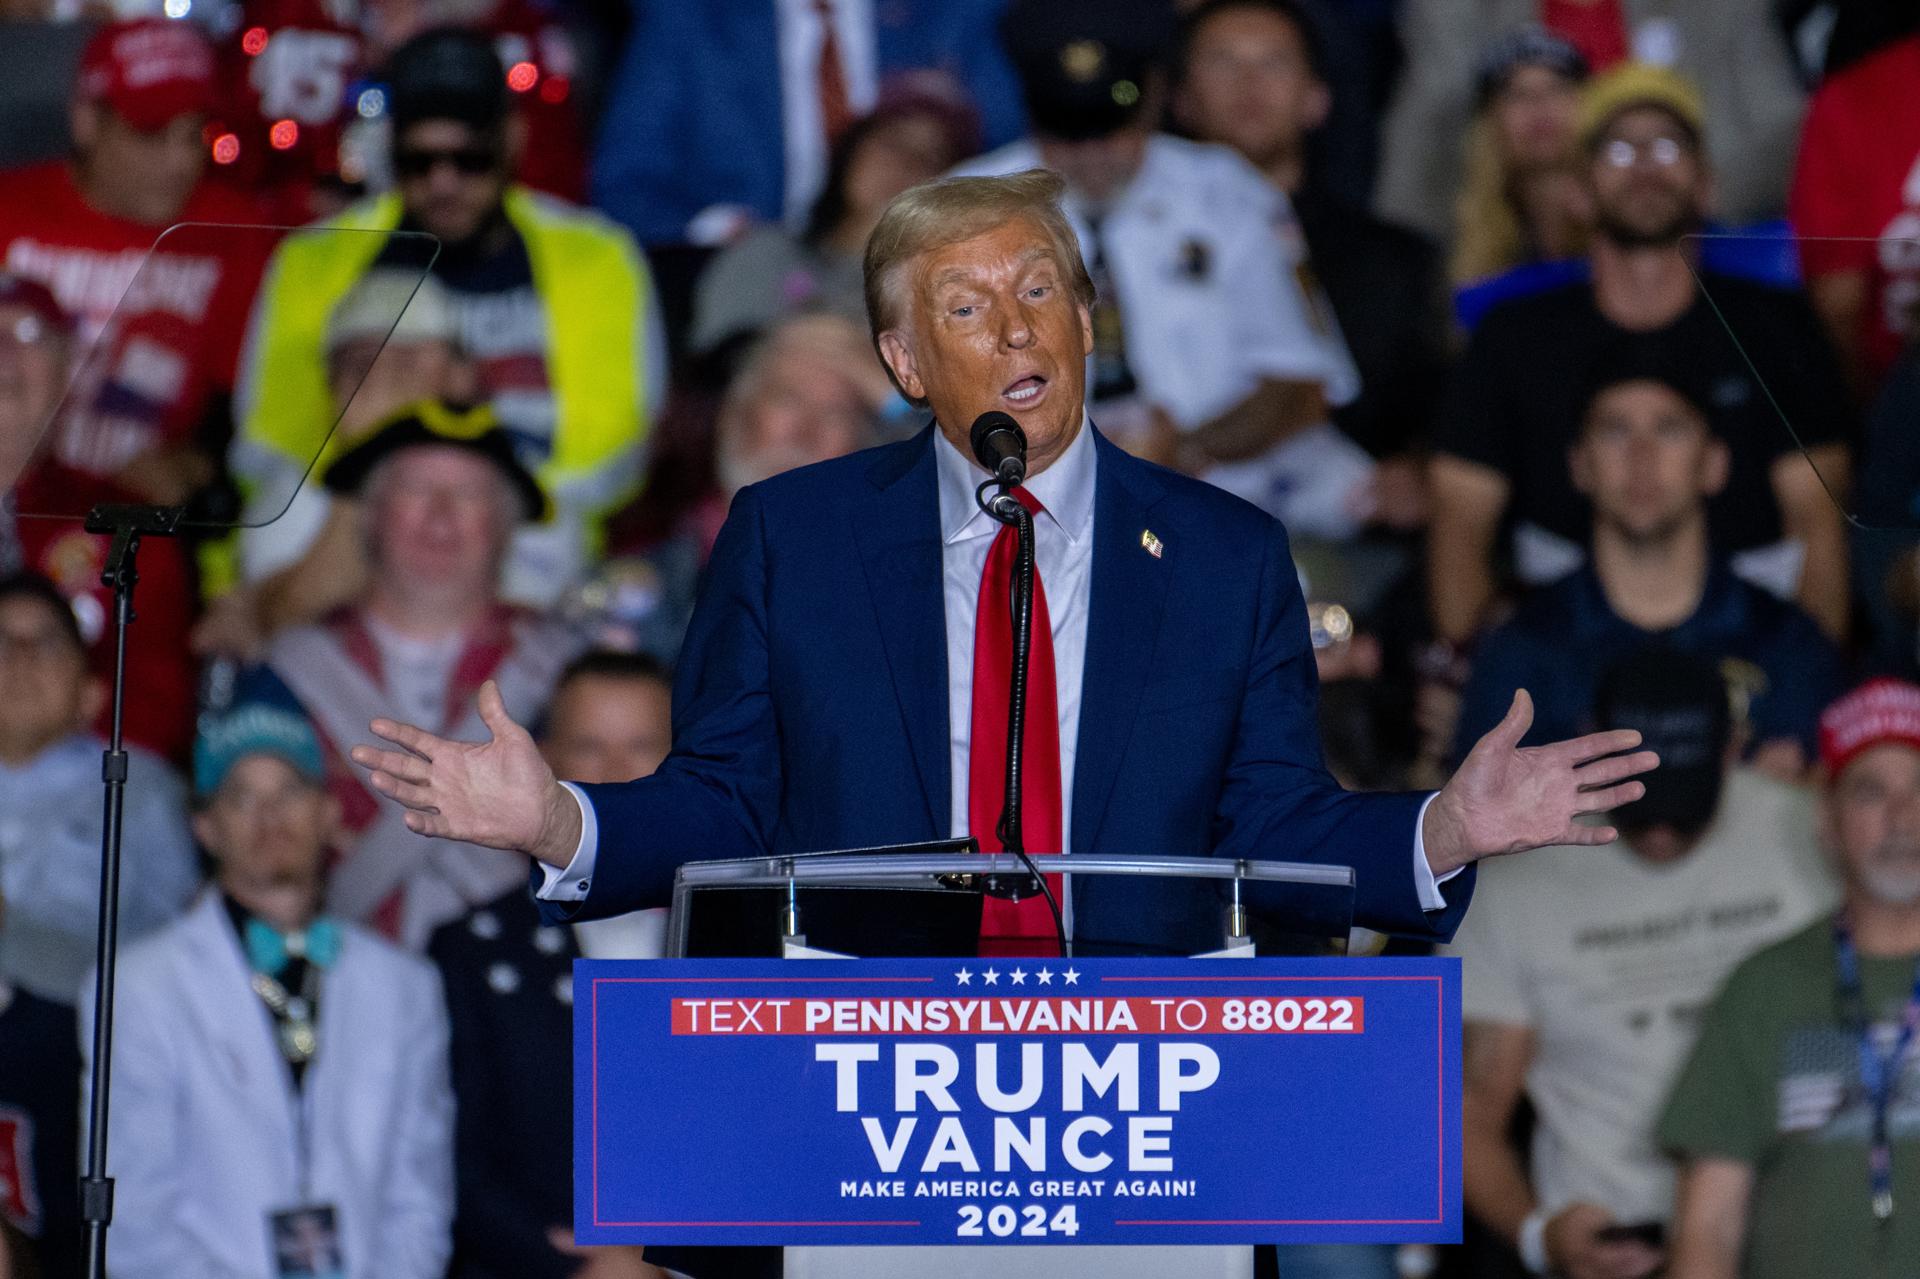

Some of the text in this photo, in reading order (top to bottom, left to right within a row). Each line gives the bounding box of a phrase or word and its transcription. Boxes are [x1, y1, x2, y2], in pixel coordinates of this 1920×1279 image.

[683, 999, 1354, 1032] TEXT PENNSYLVANIA TO 88022
[815, 1043, 1220, 1112] TRUMP
[861, 1116, 1173, 1172] VANCE
[841, 1180, 1197, 1197] MAKE AMERICA GREAT AGAIN!
[957, 1205, 1079, 1237] 2024
